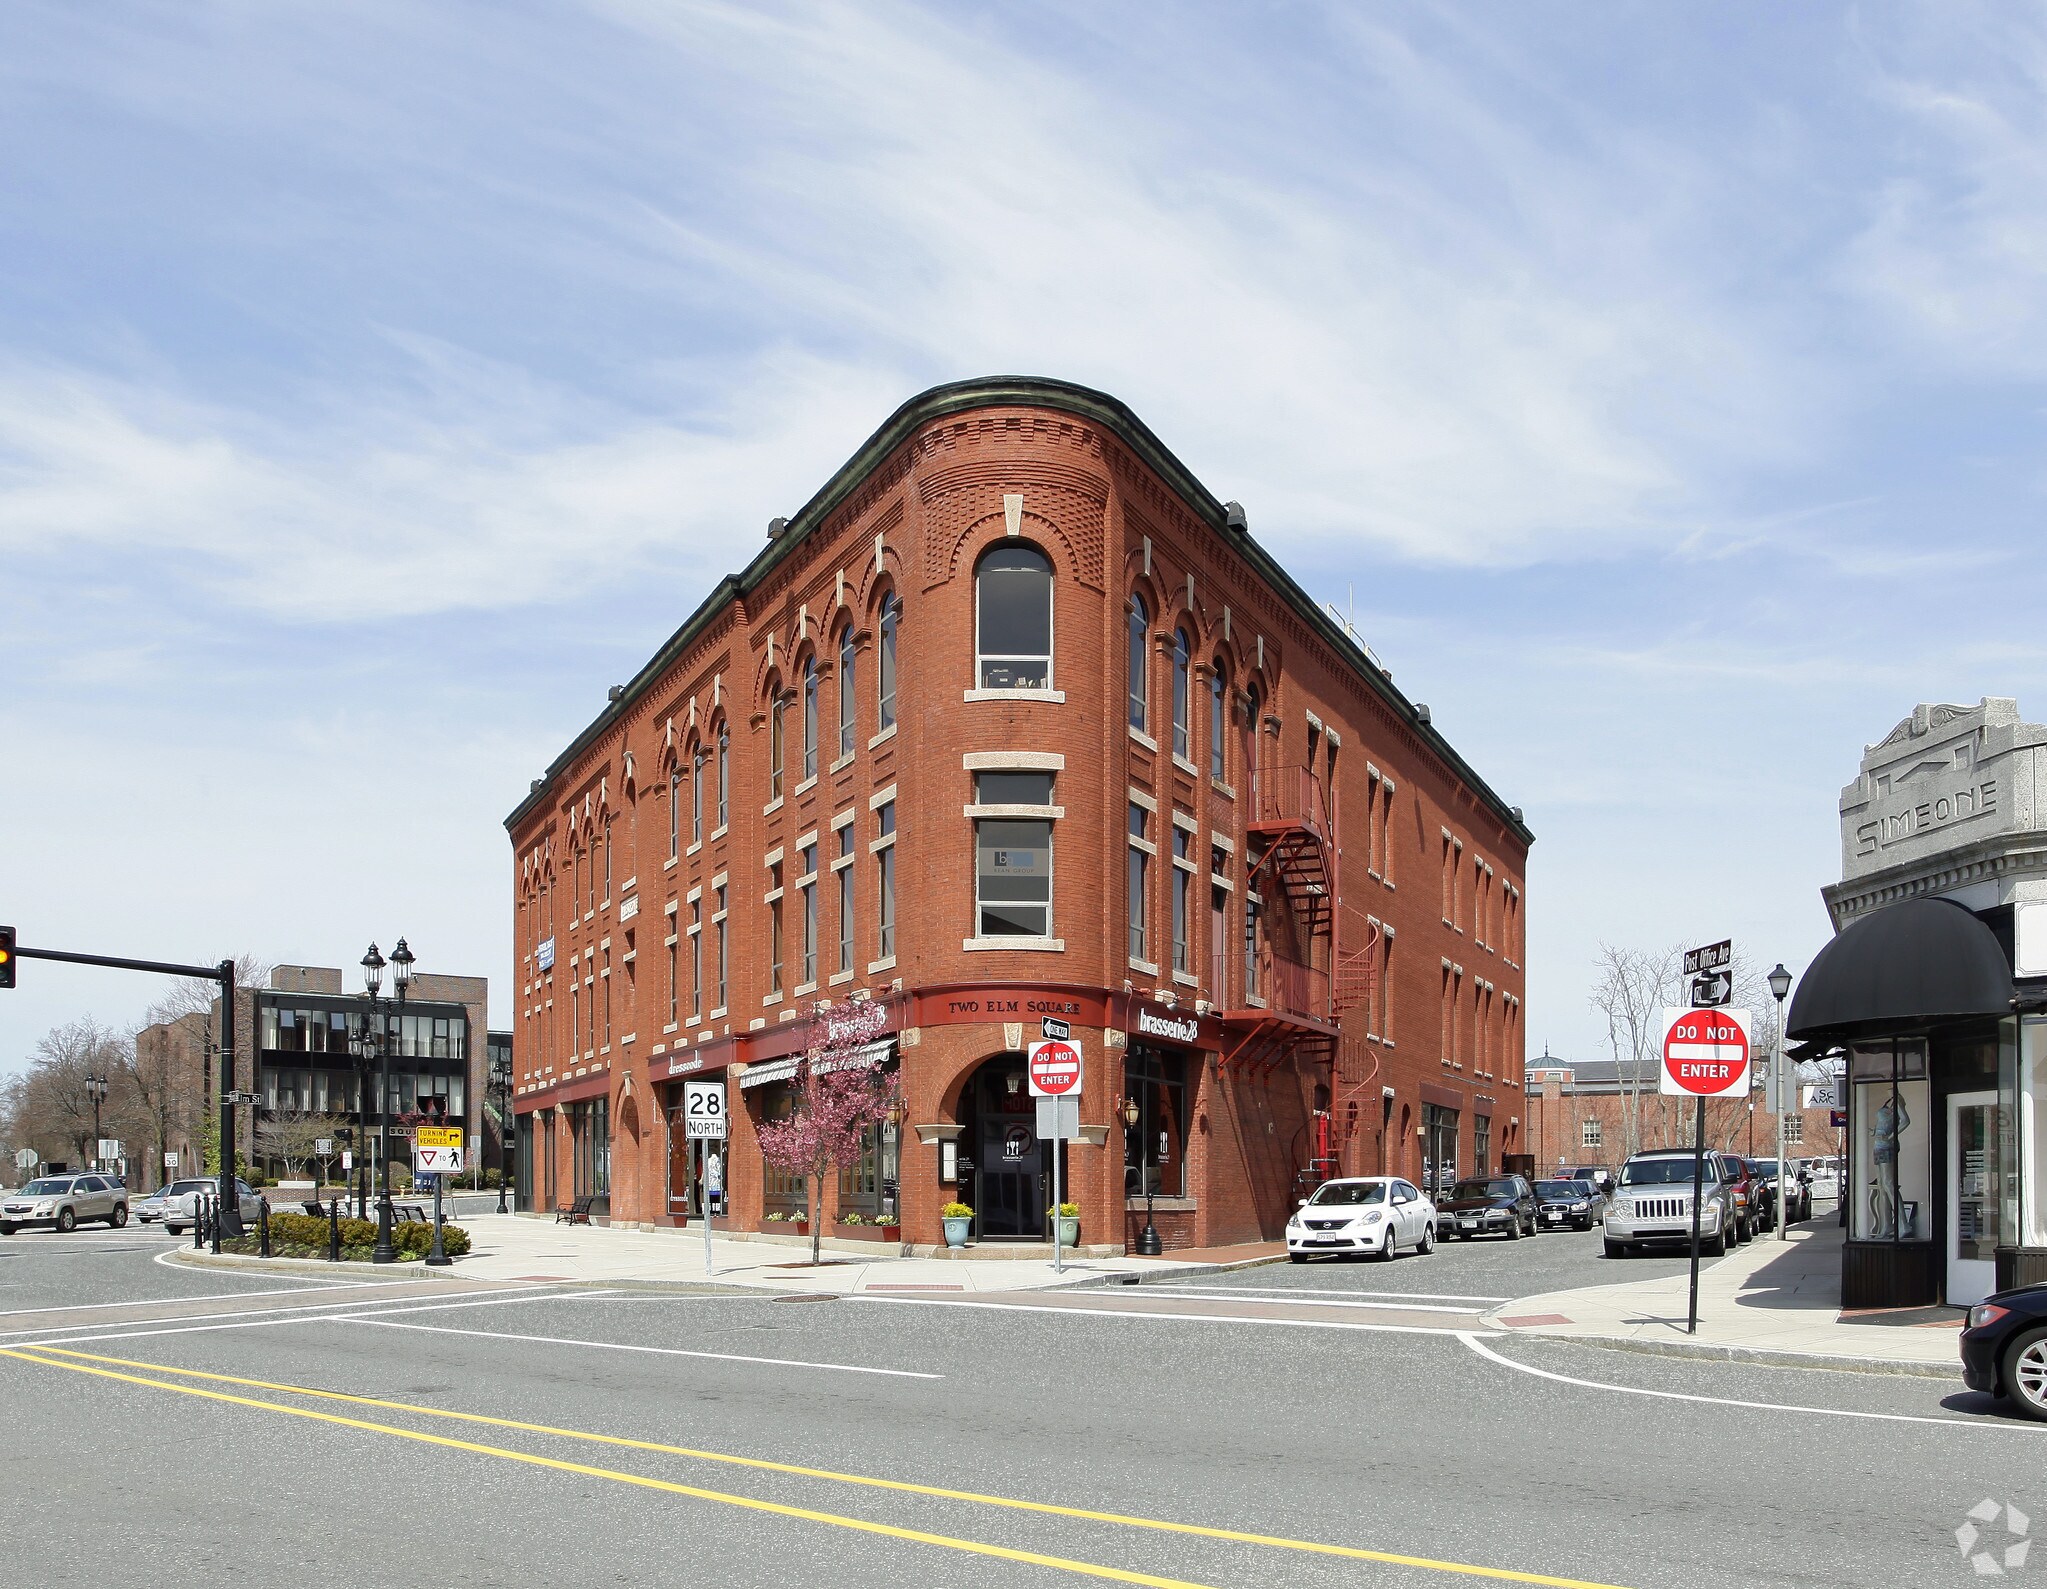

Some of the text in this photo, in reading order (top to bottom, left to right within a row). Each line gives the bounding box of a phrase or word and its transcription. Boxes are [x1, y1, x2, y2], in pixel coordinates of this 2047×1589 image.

[1856, 780, 1997, 858] SIMEONE
[1685, 944, 1729, 972] Post Office Ave
[949, 1001, 1080, 1015] TWO ELM SQUARE
[1050, 1024, 1067, 1036] ONE WAY
[1676, 1026, 1736, 1040] DO NOT
[668, 1050, 704, 1075] dresscode
[1037, 1052, 1073, 1061] DO NOT
[1681, 1063, 1729, 1078] ENTER
[1041, 1076, 1070, 1085] ENTER
[252, 1095, 260, 1103] St
[690, 1092, 720, 1115] 28
[689, 1121, 723, 1134] NORTH
